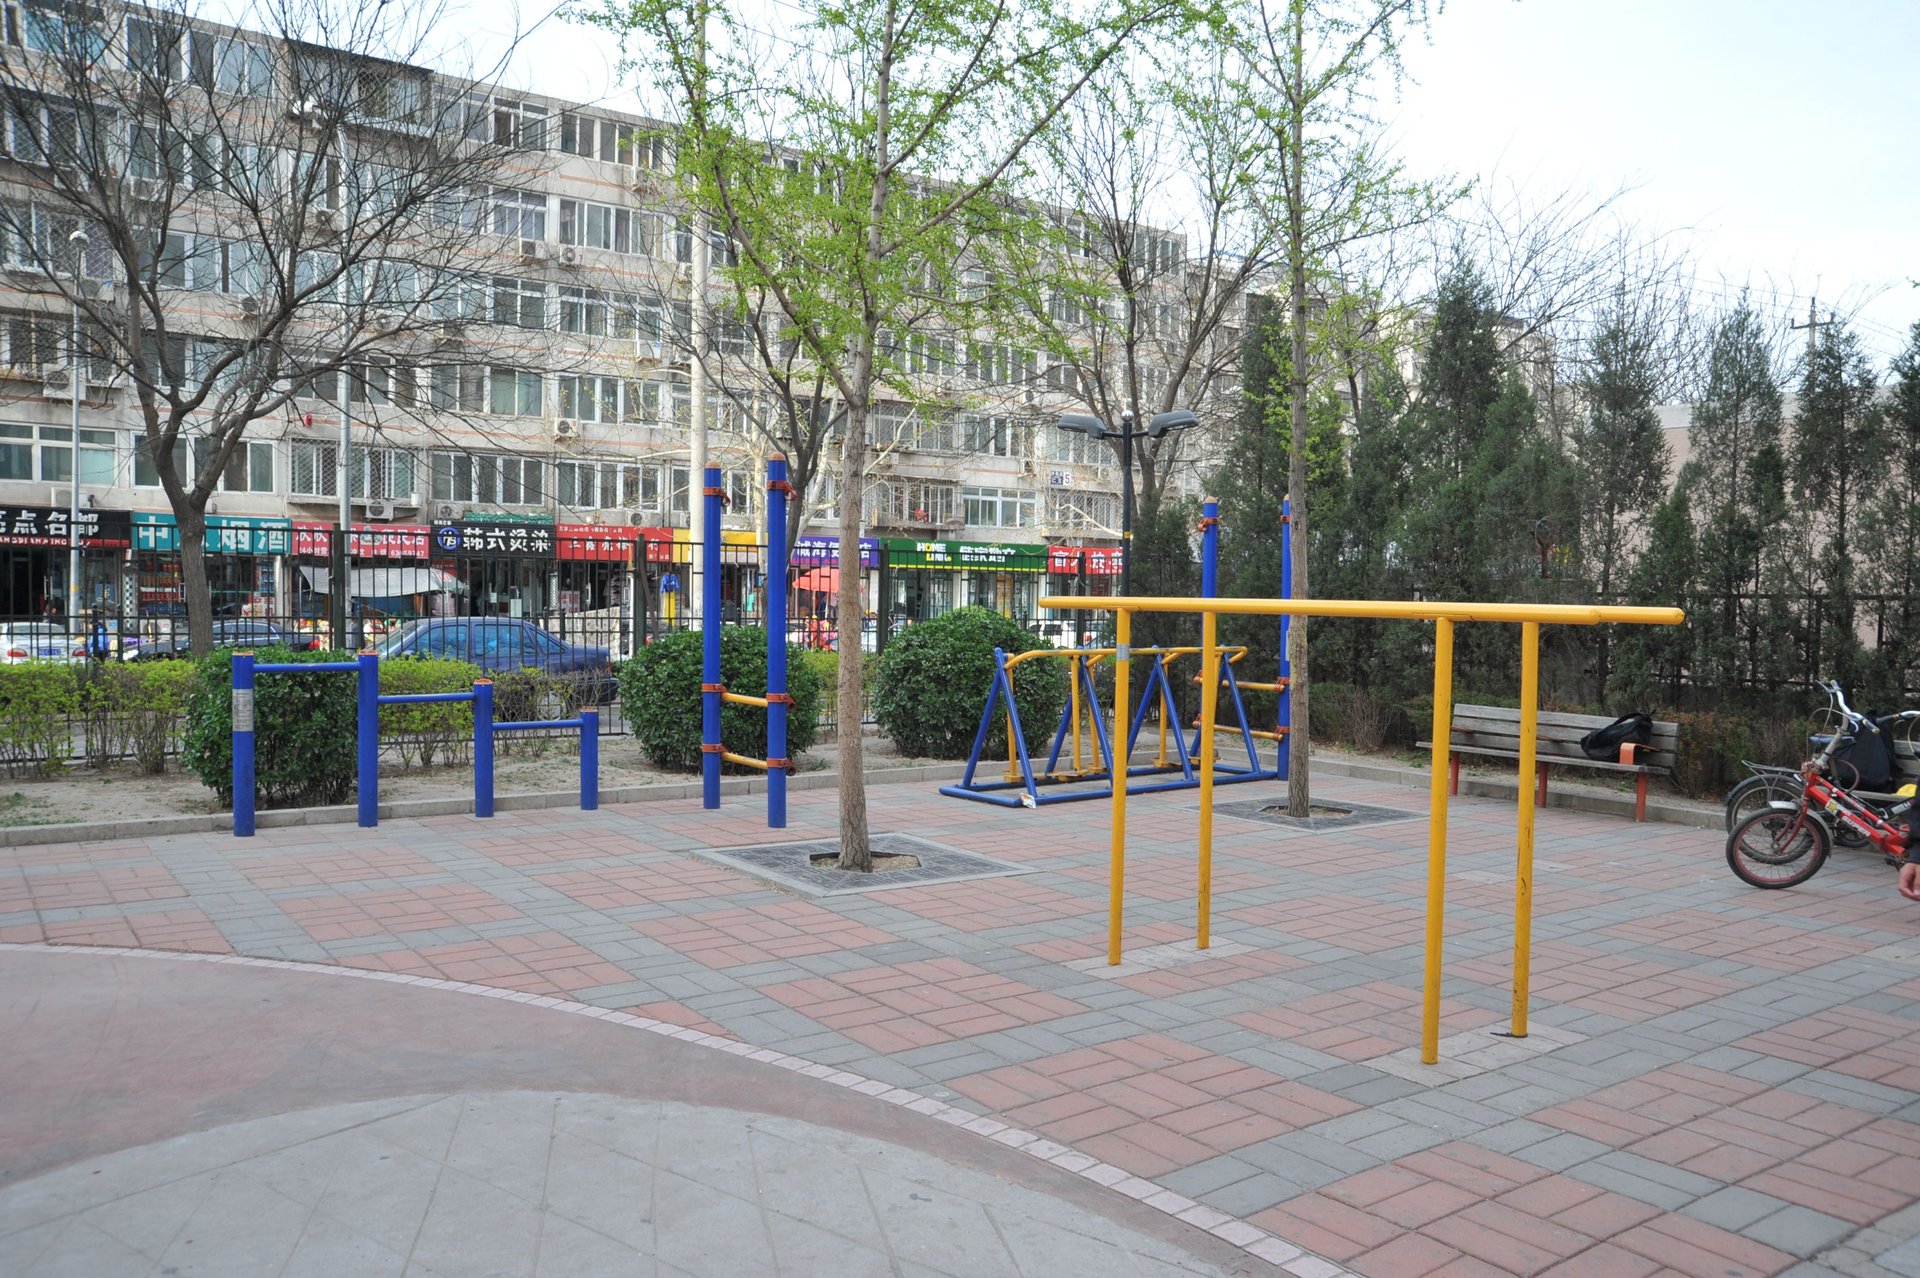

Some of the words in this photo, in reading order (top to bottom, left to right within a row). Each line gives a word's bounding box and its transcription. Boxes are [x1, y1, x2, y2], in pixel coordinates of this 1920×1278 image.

[137, 516, 288, 550] 中烟酒
[797, 540, 872, 559] 诚海便店
[916, 542, 946, 552] HOME
